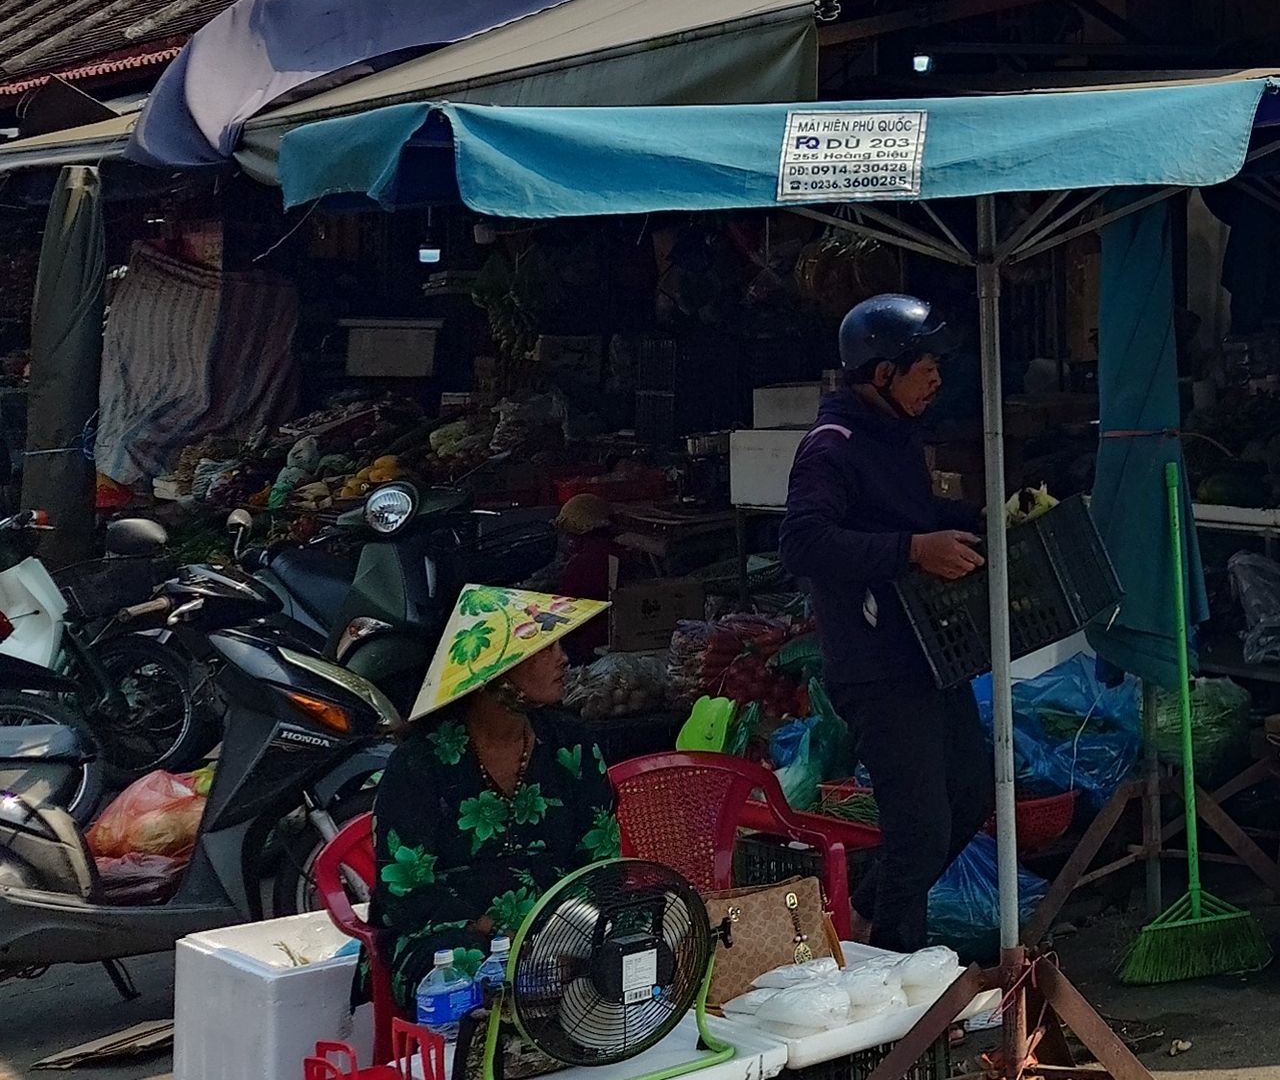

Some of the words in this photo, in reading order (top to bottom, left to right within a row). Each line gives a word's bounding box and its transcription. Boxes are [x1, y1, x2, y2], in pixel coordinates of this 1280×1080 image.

[822, 119, 849, 131] HIÊN
[852, 117, 874, 131] PHÚ
[878, 116, 912, 131] QUỐC
[827, 135, 860, 149] DÙ
[870, 138, 909, 148] 203
[281, 730, 331, 748] HONDA
